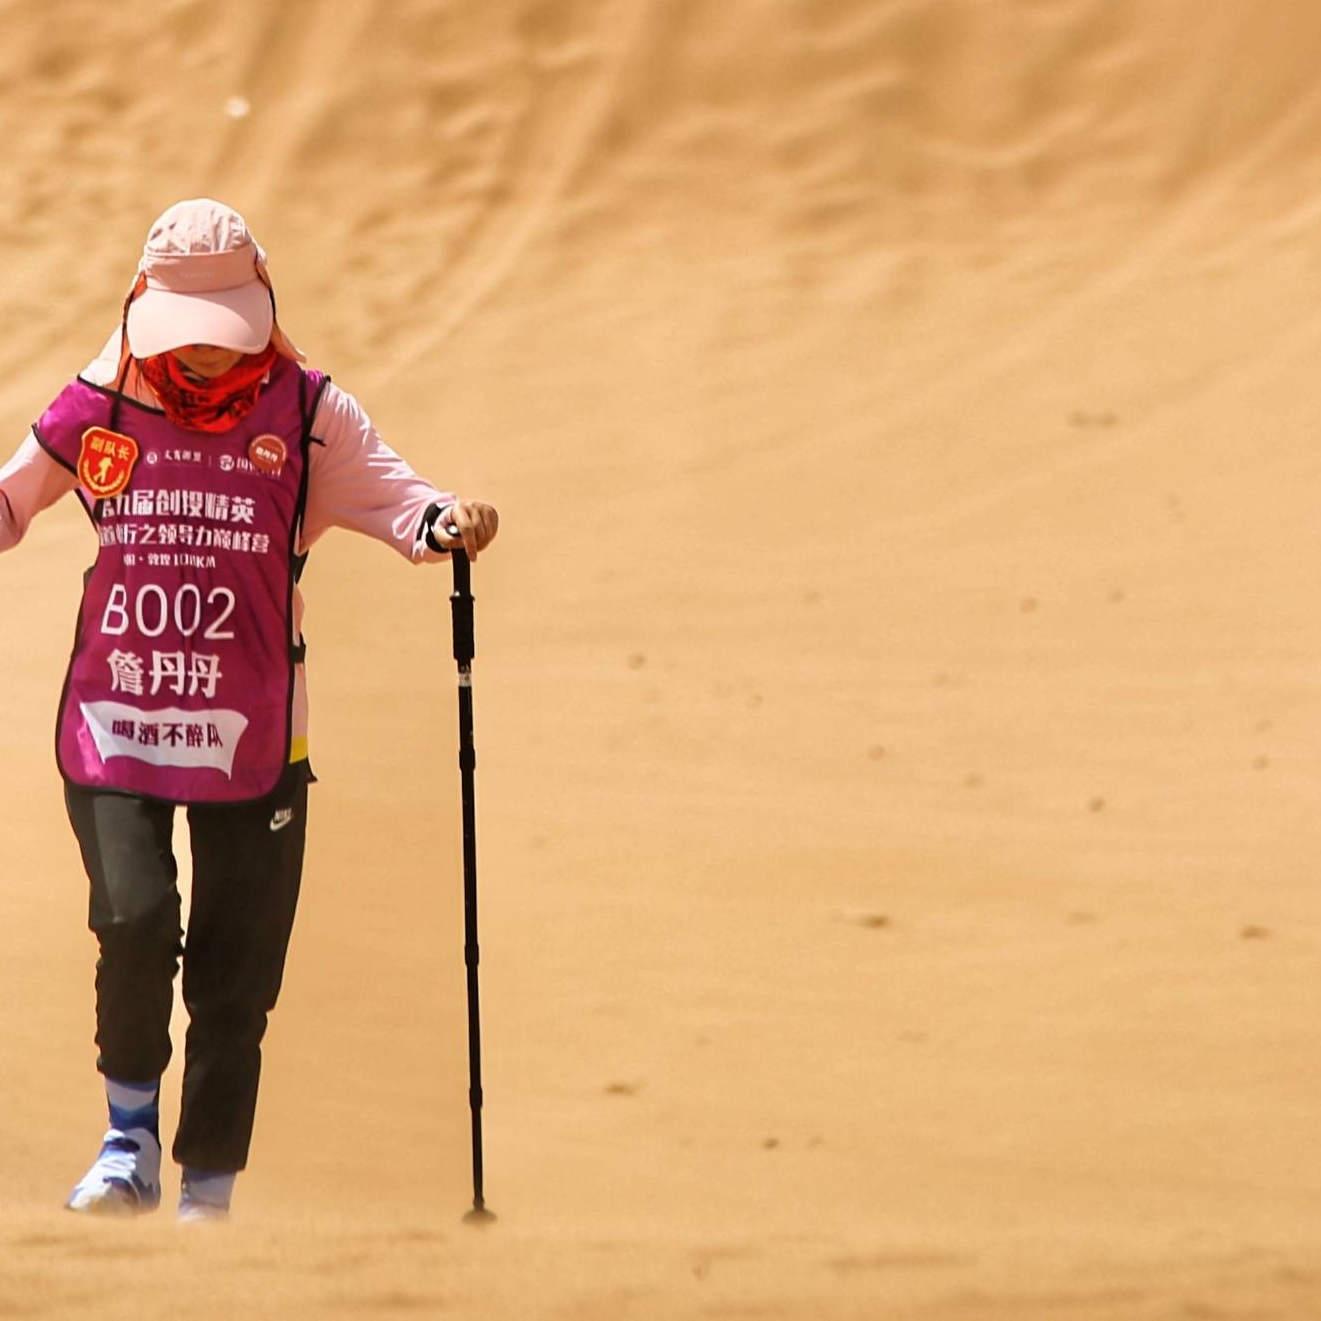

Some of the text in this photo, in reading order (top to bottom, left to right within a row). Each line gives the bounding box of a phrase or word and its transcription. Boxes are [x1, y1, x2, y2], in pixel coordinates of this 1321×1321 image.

[101, 583, 235, 639] B002
[106, 648, 223, 698] 詹丹丹
[112, 719, 223, 748] 喝酒不醉队
